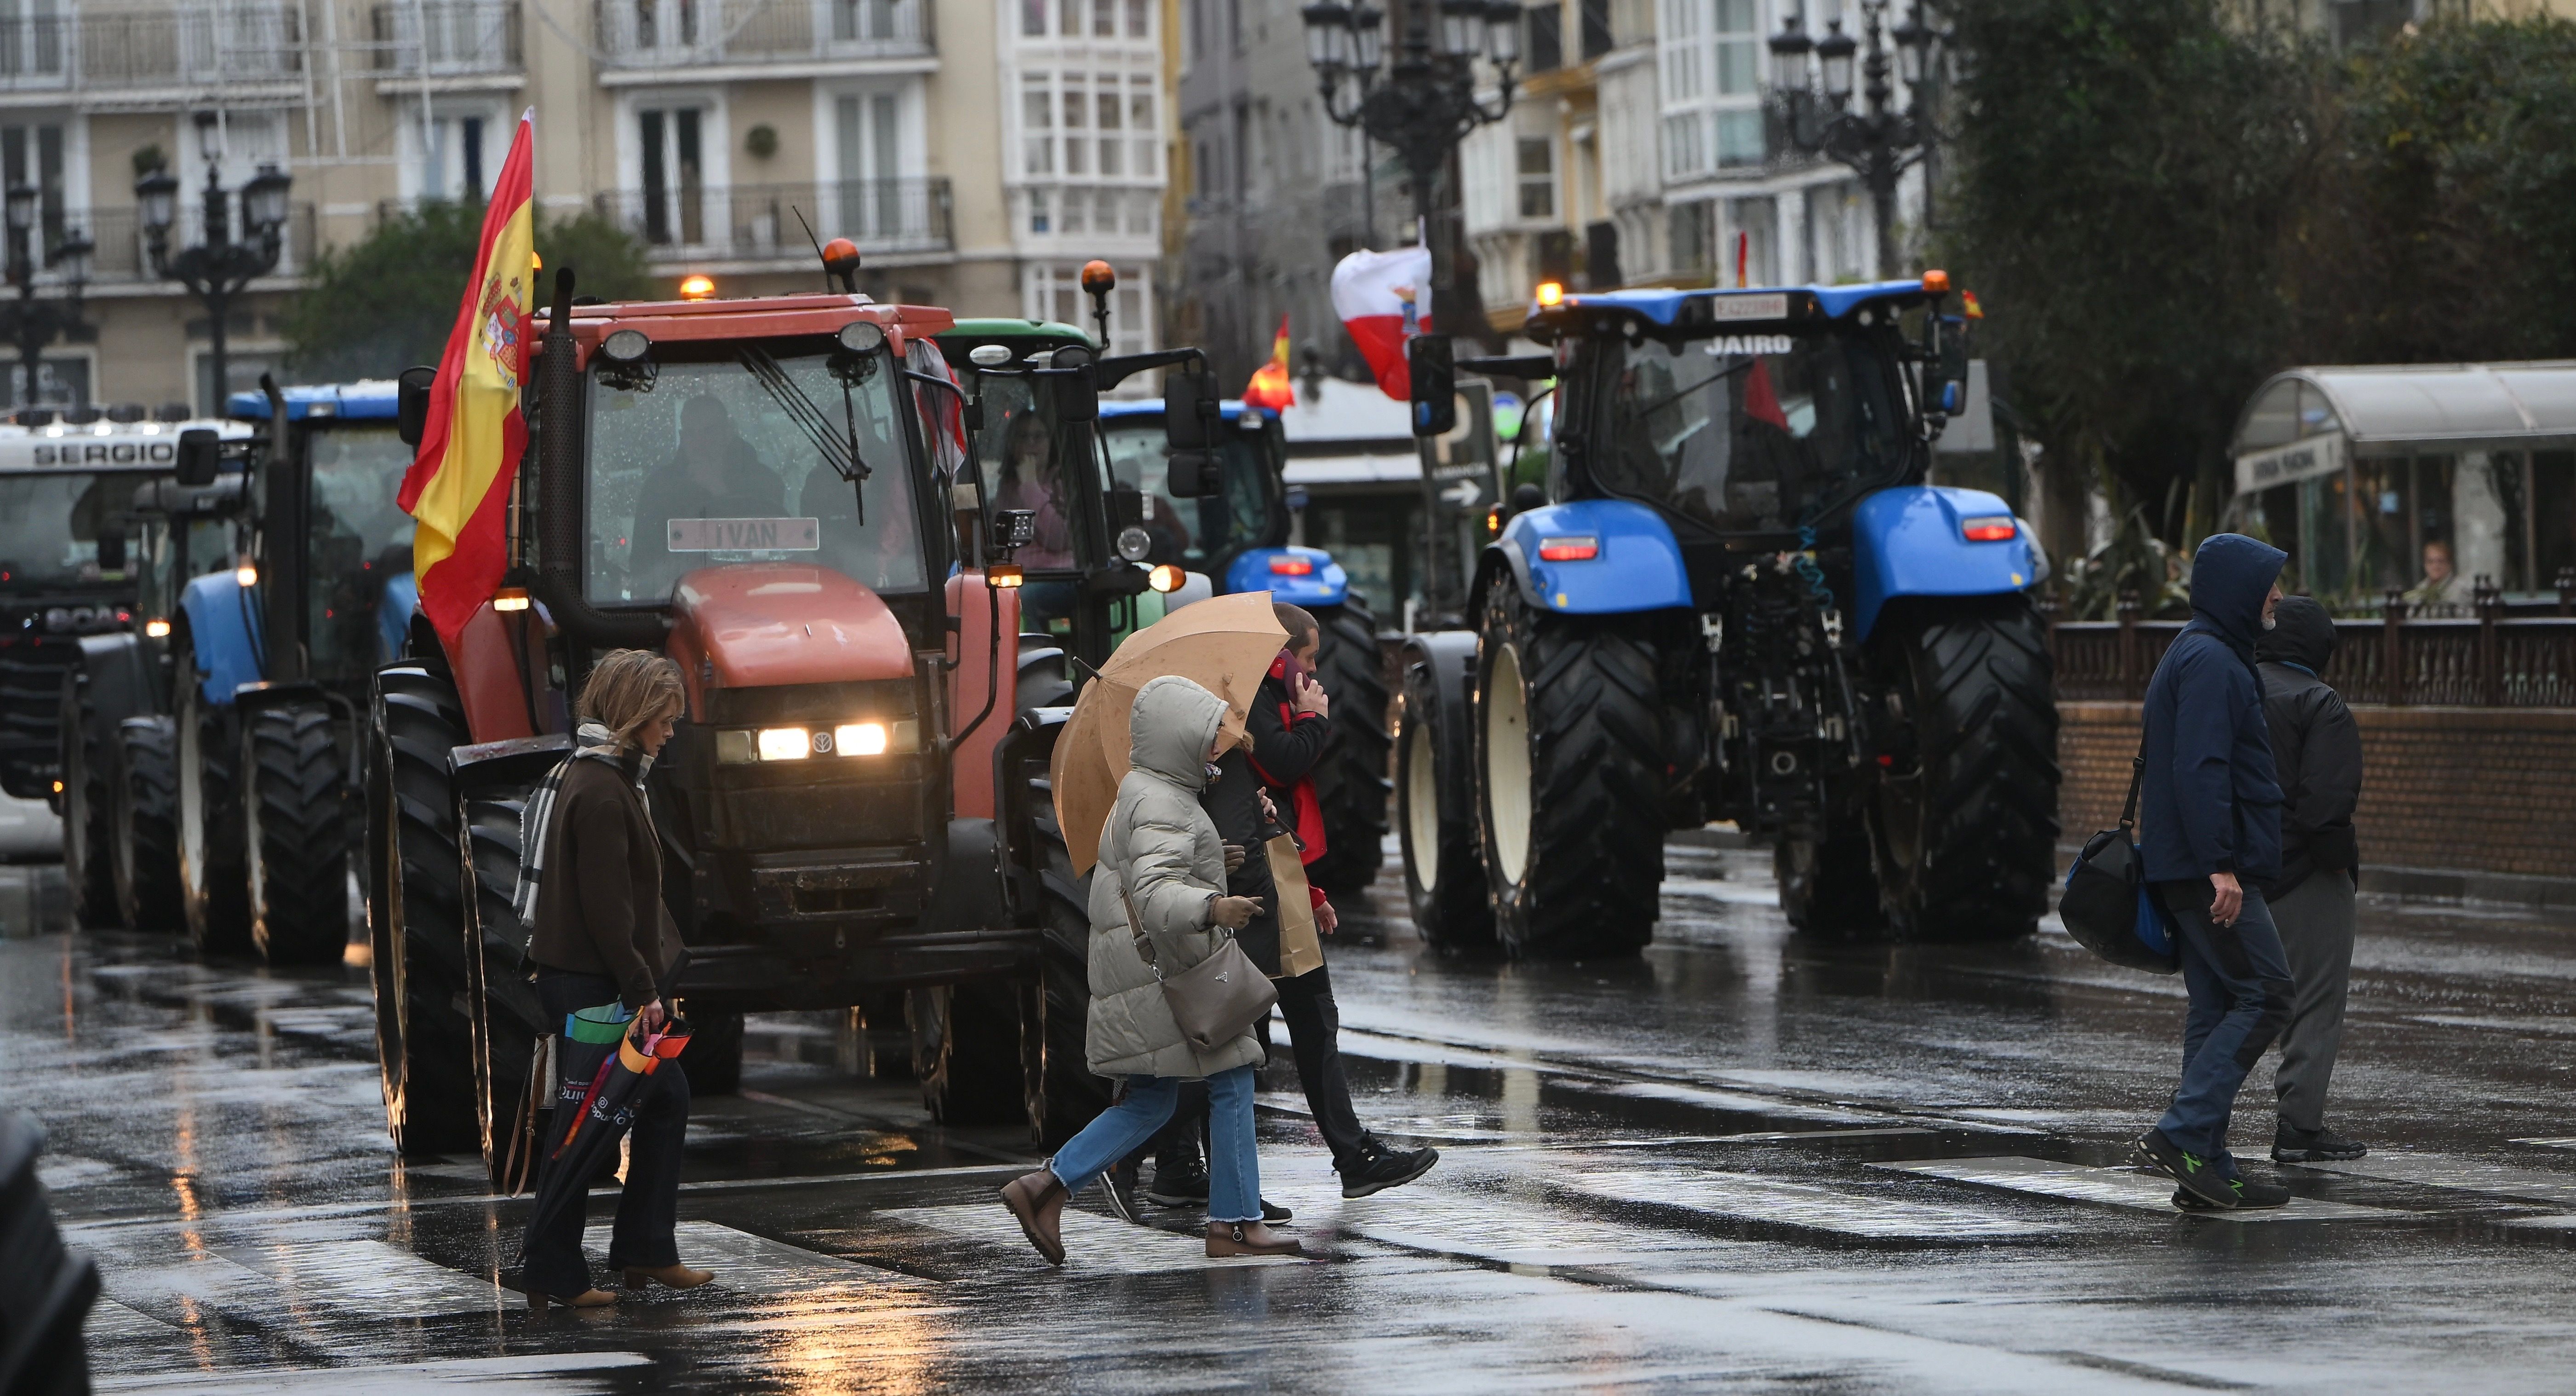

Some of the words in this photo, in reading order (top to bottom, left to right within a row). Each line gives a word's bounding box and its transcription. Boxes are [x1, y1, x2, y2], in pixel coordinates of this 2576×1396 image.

[1704, 334, 1792, 355] JAIRO
[34, 443, 173, 463] SERGIO
[716, 522, 778, 547] IVAN
